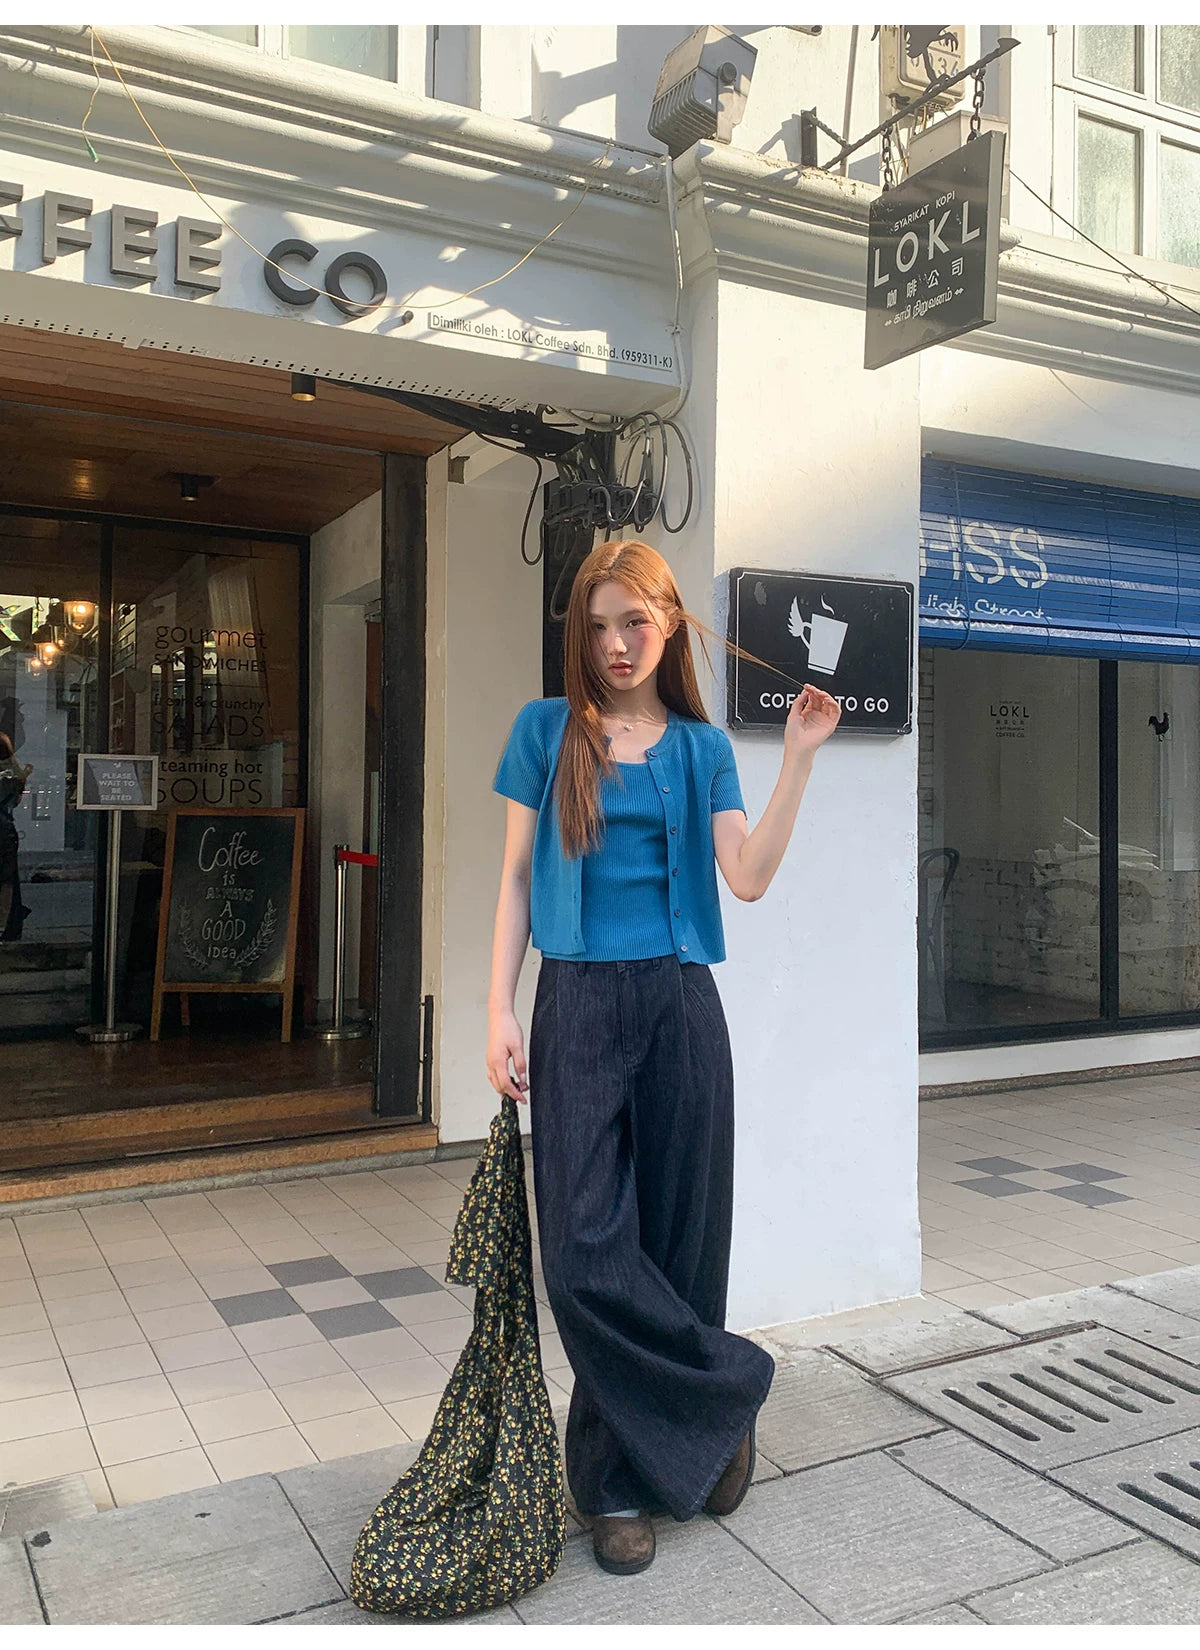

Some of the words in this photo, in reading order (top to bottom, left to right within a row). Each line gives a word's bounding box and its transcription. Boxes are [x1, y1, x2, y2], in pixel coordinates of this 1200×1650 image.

[893, 204, 929, 232] SYARIKAT
[935, 191, 955, 208] KOPI
[874, 200, 981, 288] LOKL
[432, 314, 472, 332] Dimiliki
[474, 323, 498, 337] oleh
[508, 328, 533, 343] LOKL
[535, 334, 570, 350] Coffee
[573, 340, 594, 355] Sdn.
[597, 345, 619, 360] Bhd.
[621, 349, 673, 369] (959311-K)
[155, 626, 268, 650] gourmet
[864, 697, 889, 713] GO
[990, 705, 1030, 718] LOKL
[102, 772, 132, 780] PLEASE
[234, 759, 263, 774] hot
[198, 826, 265, 872] Coffee
[222, 870, 236, 886] is
[219, 901, 233, 917] A
[202, 918, 246, 941] GOOD
